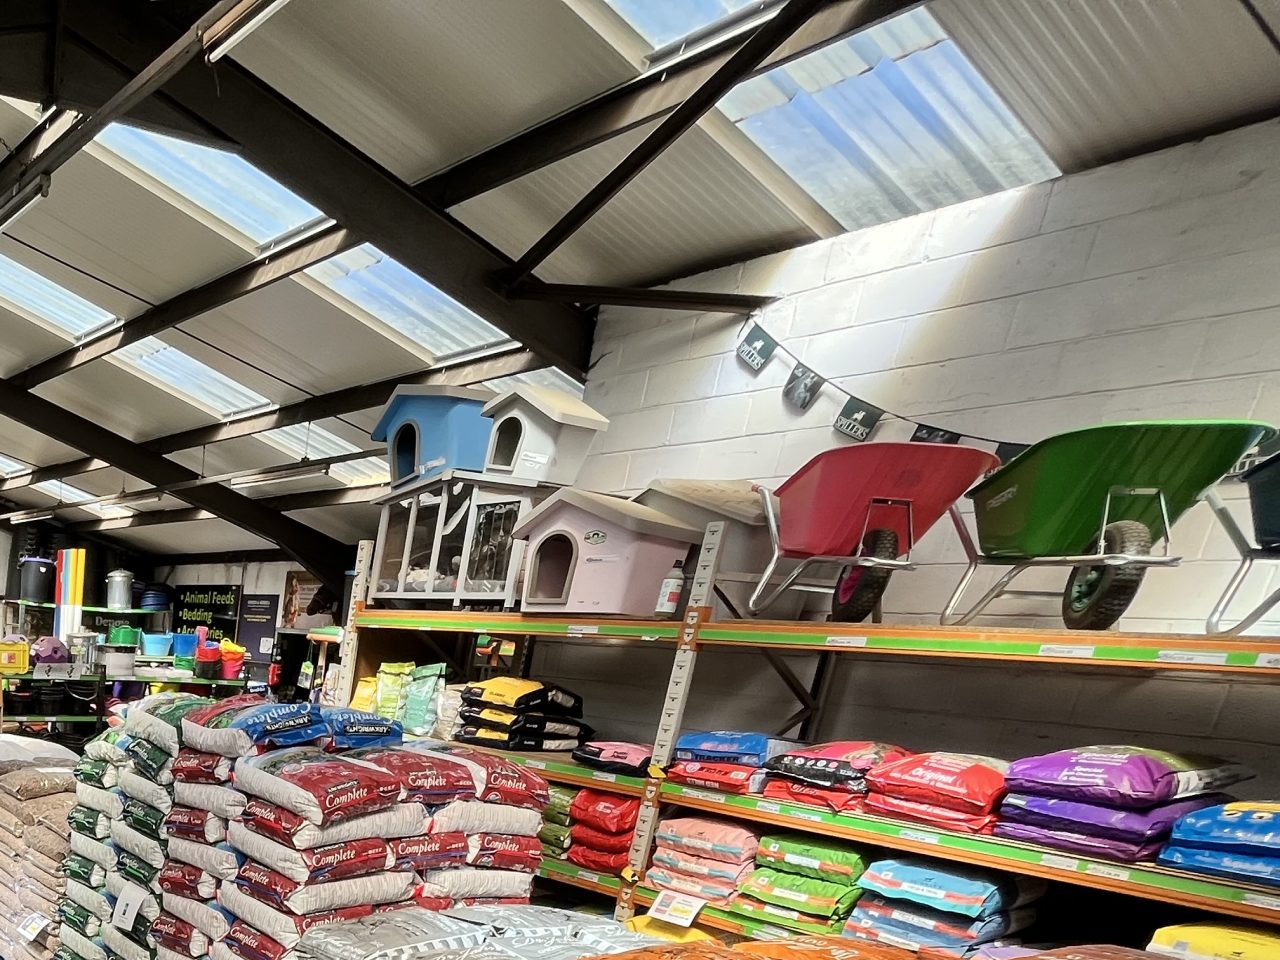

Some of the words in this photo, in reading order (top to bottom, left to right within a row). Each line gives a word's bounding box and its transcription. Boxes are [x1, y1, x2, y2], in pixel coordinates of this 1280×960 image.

[738, 343, 764, 369] SPILLERS
[835, 417, 868, 441] SPILLERS
[184, 592, 211, 604] Animal
[212, 592, 235, 604] Feeds
[183, 609, 213, 624] Bedding
[248, 701, 311, 725] Complete
[693, 754, 739, 762] TRACKER
[408, 774, 447, 790] Complete
[490, 774, 527, 791] Complete
[911, 767, 956, 784] Original
[325, 786, 368, 809] Complete
[246, 801, 276, 820] Complete
[398, 840, 441, 855] Complete
[484, 836, 520, 852] Complete
[312, 848, 356, 868] Complete
[240, 866, 269, 886] Complete
[230, 926, 259, 948] Complete
